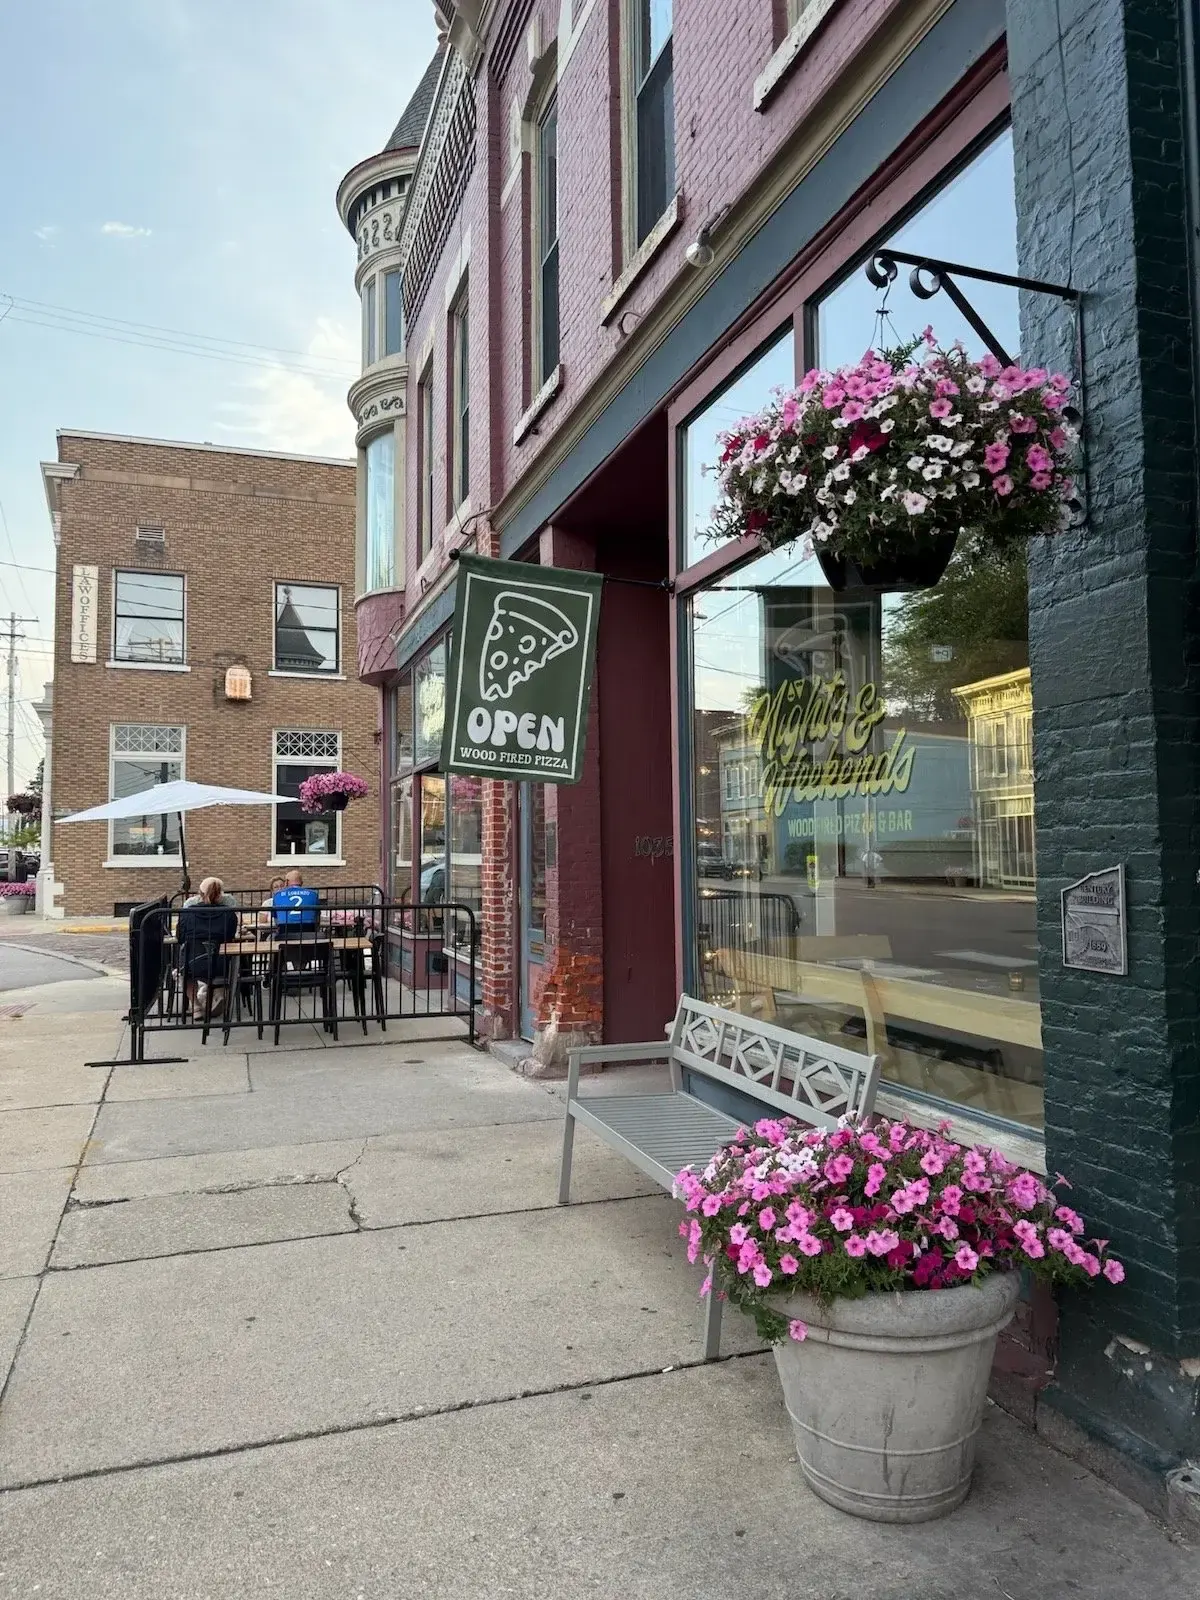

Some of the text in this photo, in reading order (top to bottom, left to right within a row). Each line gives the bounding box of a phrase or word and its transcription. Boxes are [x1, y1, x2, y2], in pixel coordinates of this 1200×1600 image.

[78, 568, 92, 660] LAW OFFICES
[467, 707, 564, 753] OPEN
[749, 670, 887, 766] Nights &
[460, 747, 569, 769] WOOD FIRED PIZZA
[759, 727, 916, 817] Weekends
[787, 818, 814, 838] WOOD
[878, 811, 887, 833] &
[888, 809, 913, 832] BAR
[289, 895, 303, 915] 2
